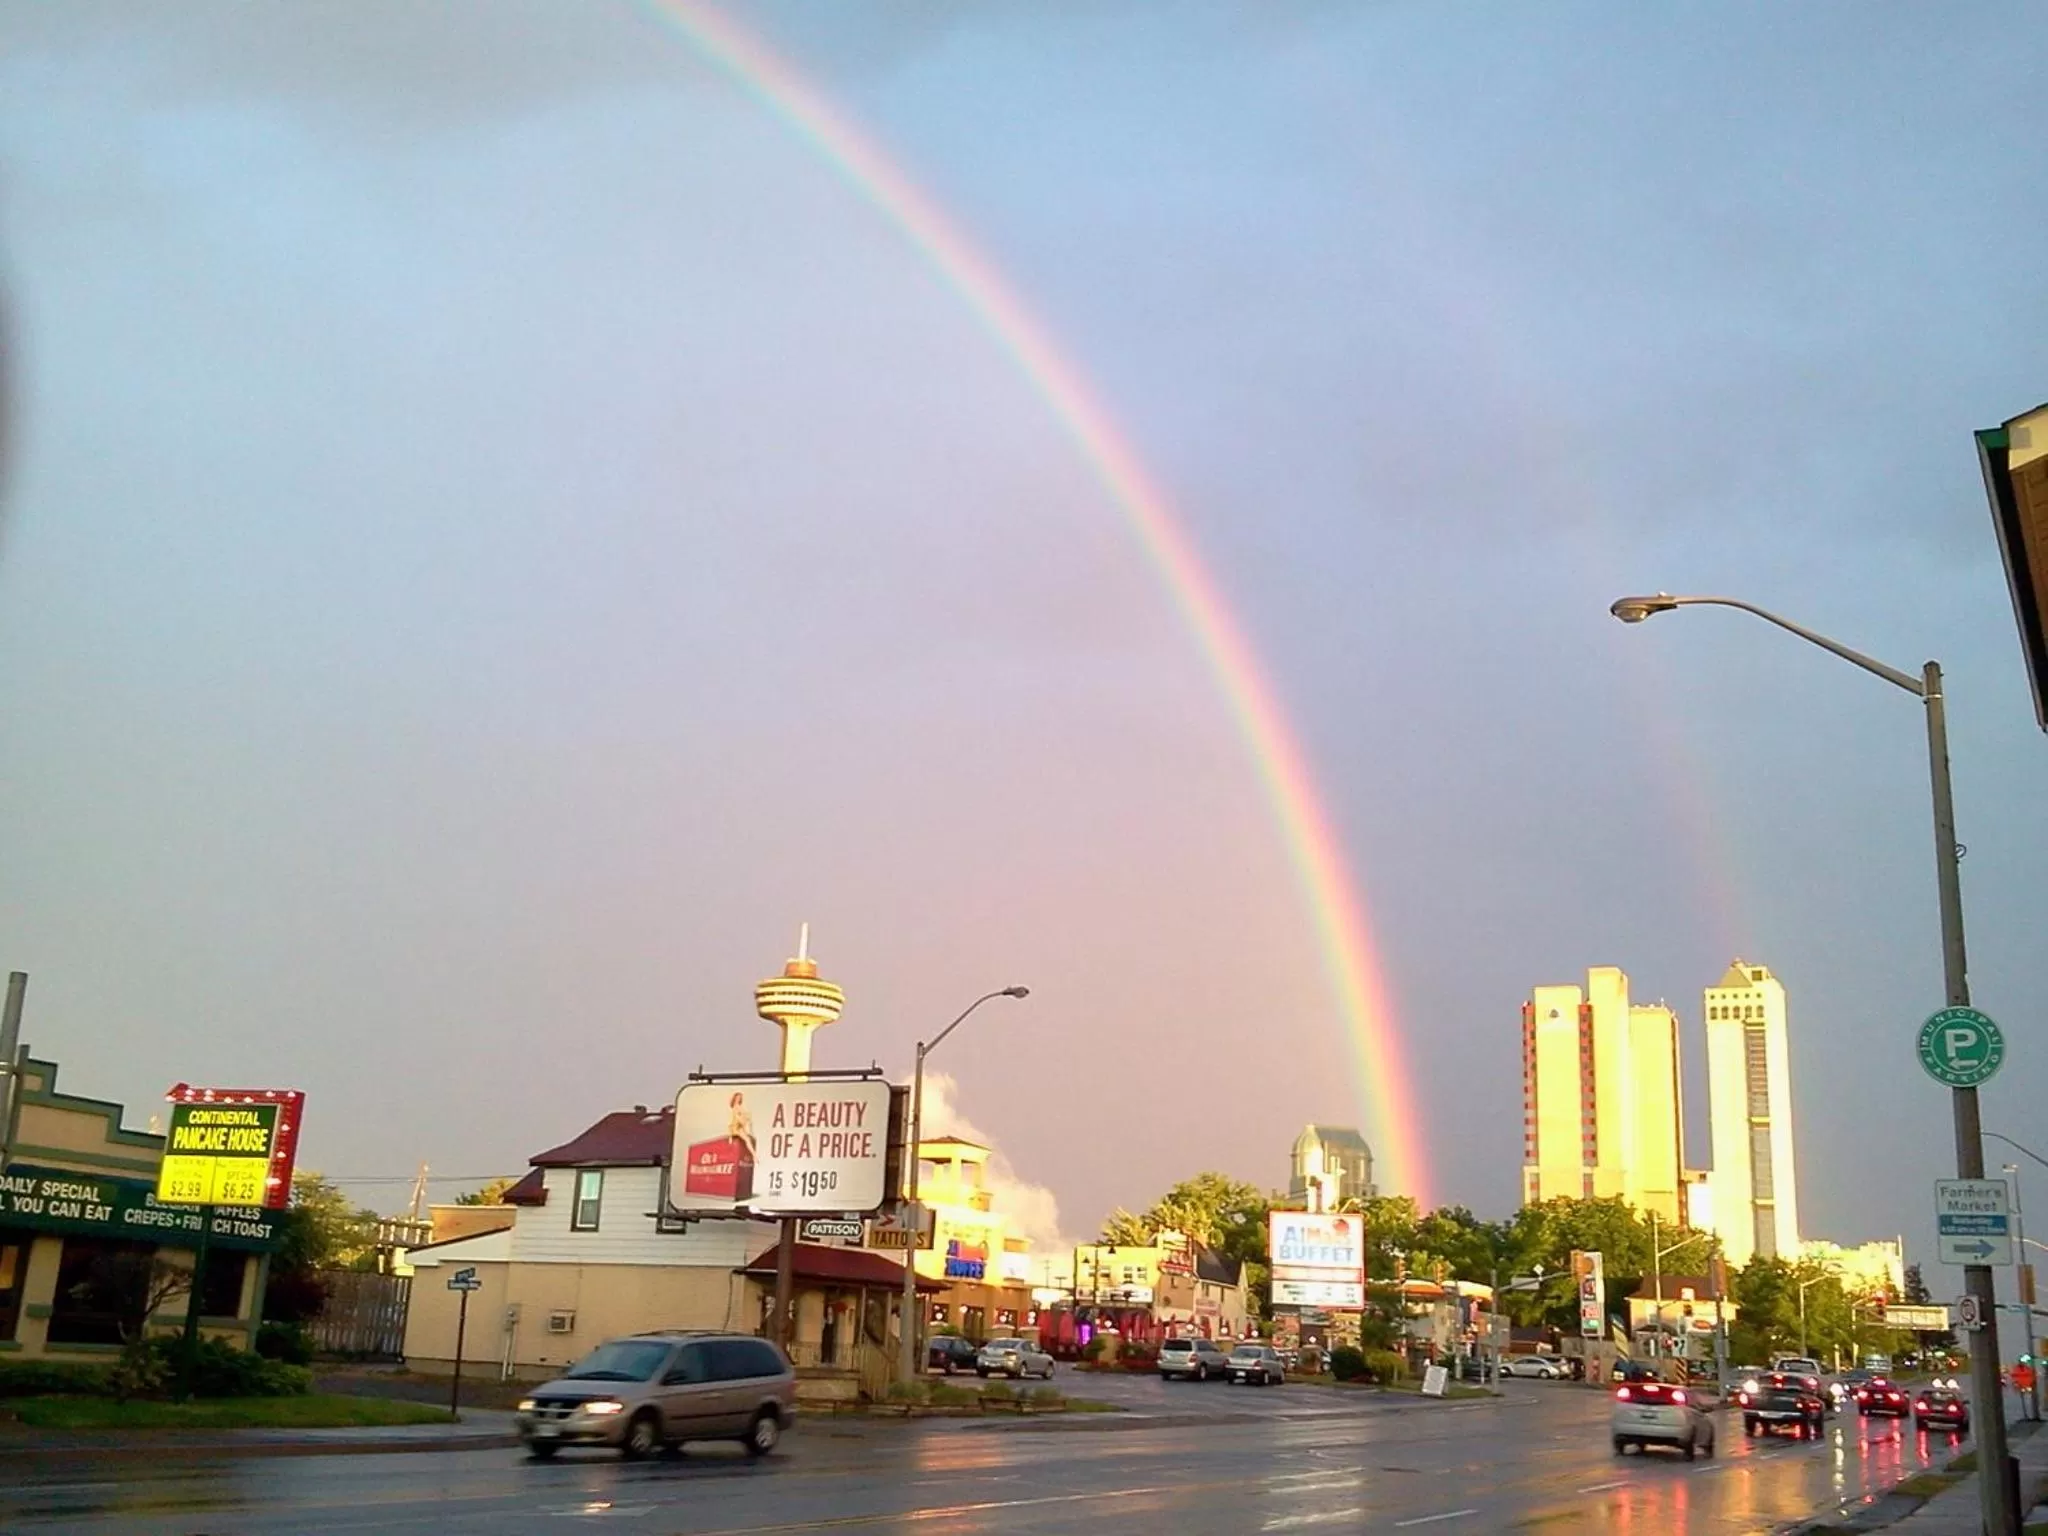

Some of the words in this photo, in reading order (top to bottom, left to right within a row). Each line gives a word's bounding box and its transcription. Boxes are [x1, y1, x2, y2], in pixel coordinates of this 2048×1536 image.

[1921, 1009, 2000, 1046] MUNICIPAL
[1945, 1028, 1978, 1058] P
[188, 1110, 260, 1126] CONTINENTAL
[772, 1102, 785, 1128] A
[793, 1101, 867, 1128] BEAUTY
[173, 1126, 229, 1150] PANCAKE
[227, 1128, 269, 1152] HOUSE
[770, 1132, 794, 1158] OF
[797, 1132, 811, 1158] A
[818, 1132, 877, 1158] PRICE.
[170, 1180, 201, 1198] $2.99
[769, 1171, 783, 1189] 15
[41, 1180, 101, 1202] SPECIAL
[223, 1182, 254, 1200] $6.25
[13, 1195, 44, 1215] YOU
[48, 1200, 81, 1219] CAN
[84, 1204, 113, 1221] EAT
[1947, 1200, 1997, 1212] Market
[124, 1208, 175, 1228] CREPES
[233, 1219, 273, 1240] TOAST
[809, 1223, 860, 1236] PATTISON
[873, 1230, 926, 1247] TATTOS
[1279, 1243, 1355, 1263] BUFFET
